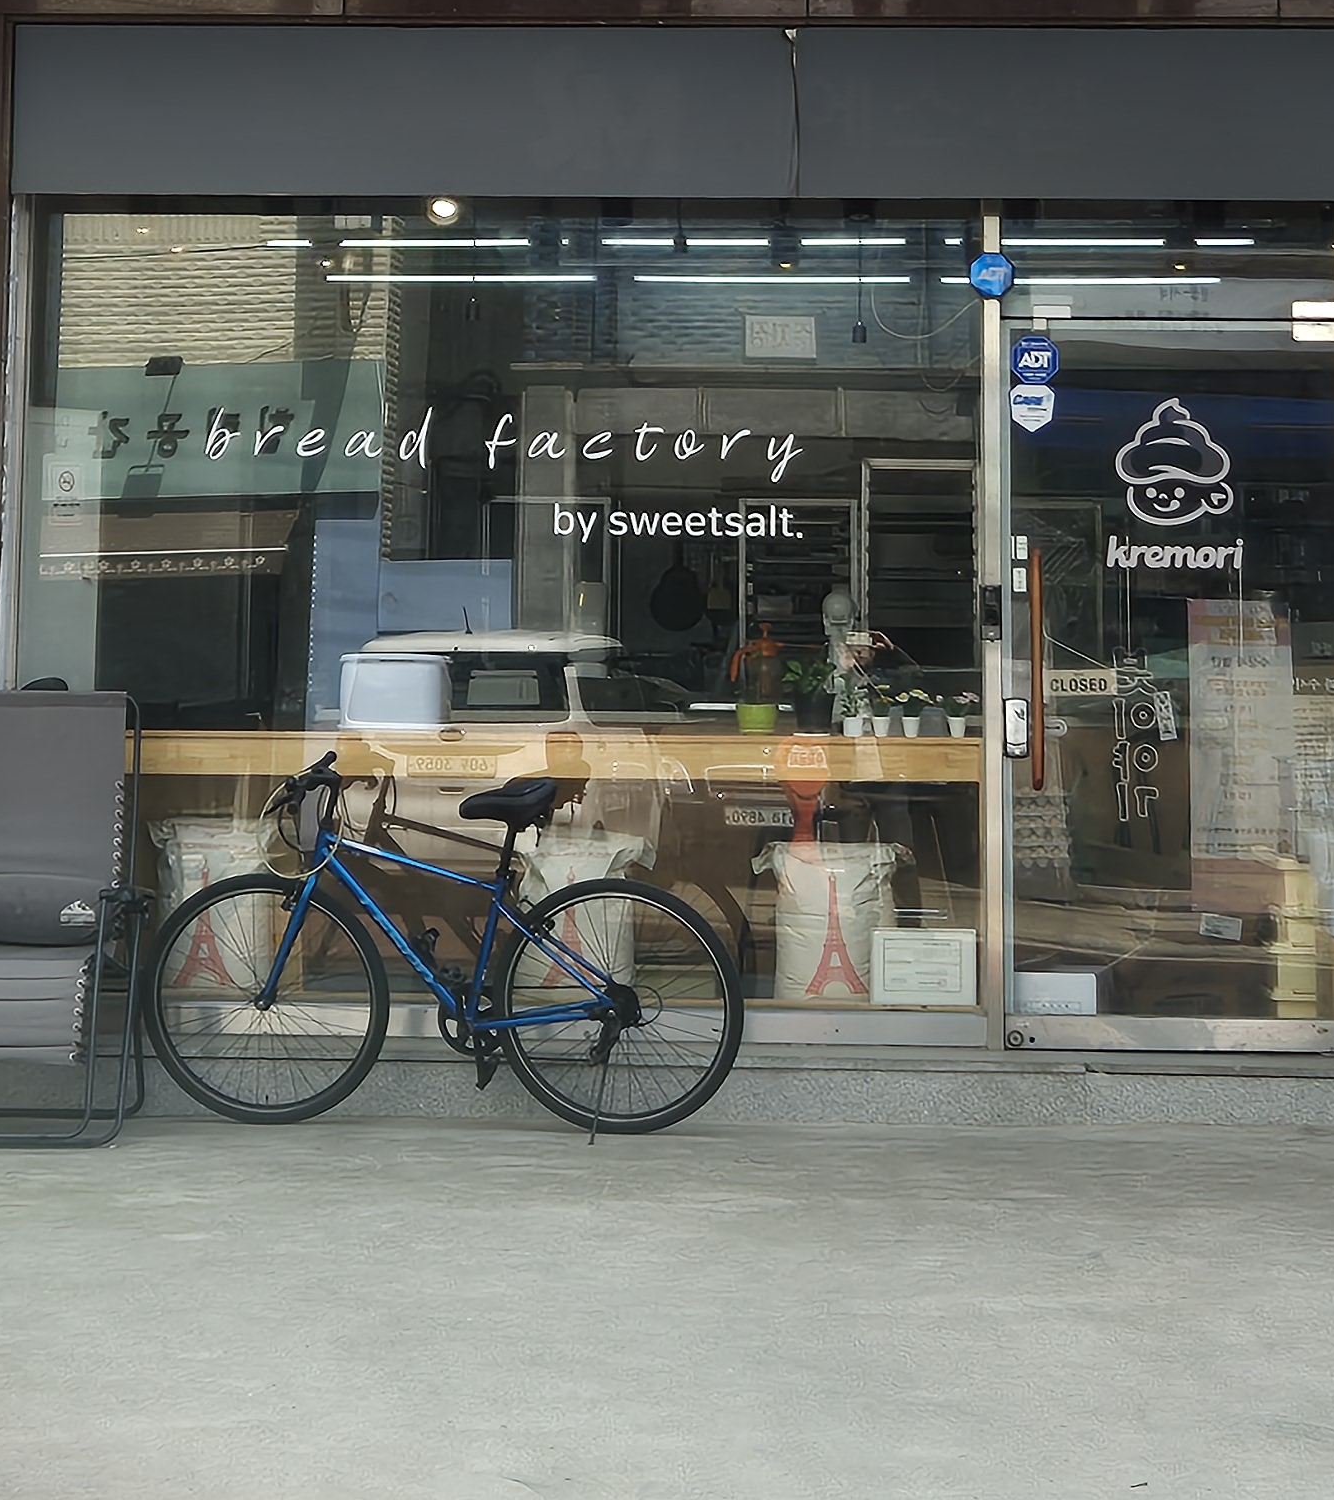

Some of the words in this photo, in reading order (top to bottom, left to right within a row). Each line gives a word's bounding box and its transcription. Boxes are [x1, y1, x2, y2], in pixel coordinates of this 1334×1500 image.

[1018, 350, 1052, 368] ADT
[204, 406, 433, 470] bread
[484, 413, 803, 483] factory
[554, 503, 596, 542] by
[1106, 534, 1244, 569] kremori
[1050, 677, 1108, 692] CLOSED
